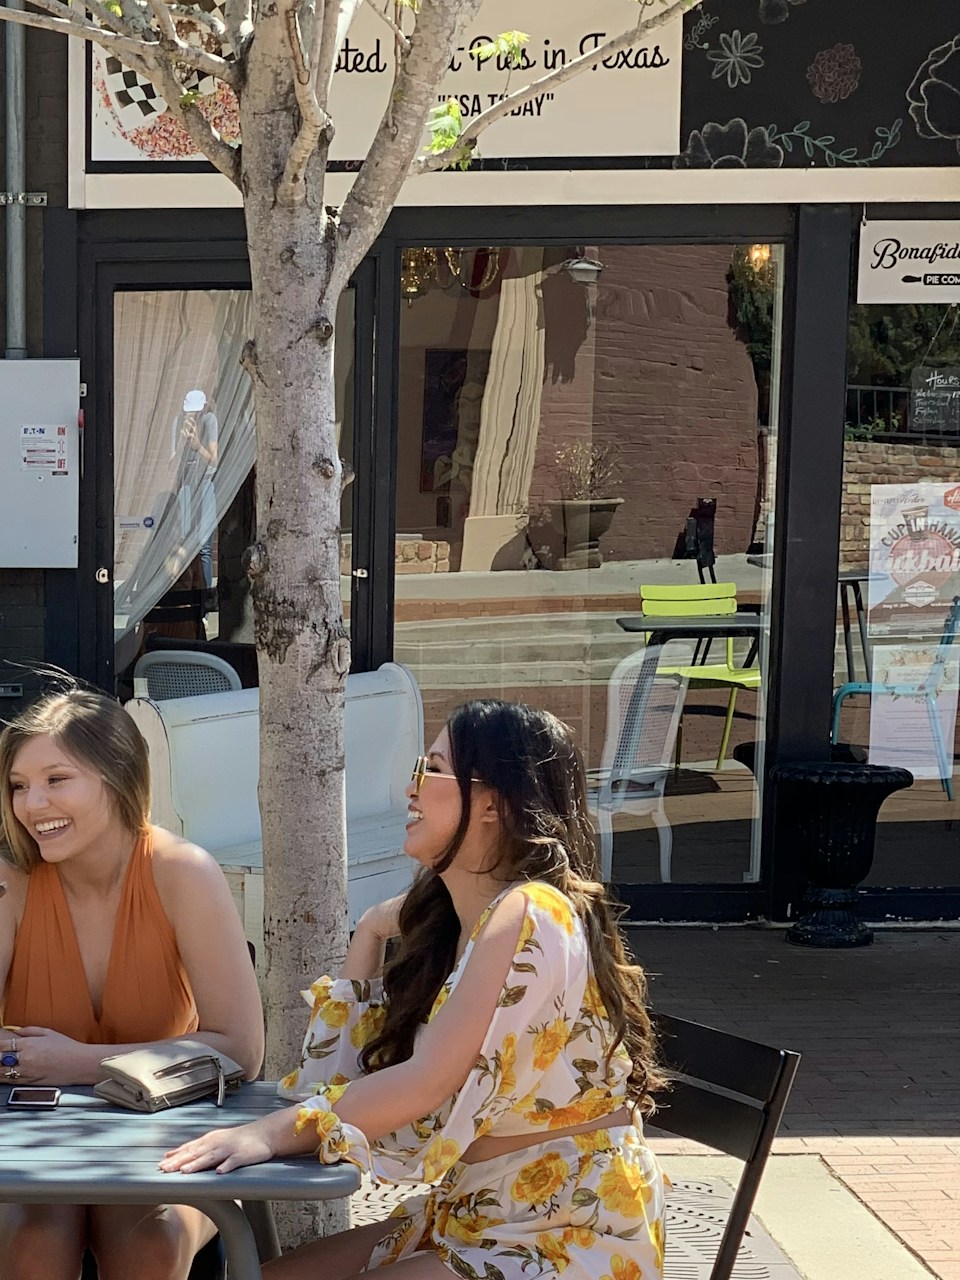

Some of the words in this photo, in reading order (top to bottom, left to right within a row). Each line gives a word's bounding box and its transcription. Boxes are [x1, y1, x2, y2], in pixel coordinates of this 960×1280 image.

[544, 39, 566, 70] in
[438, 94, 481, 117] "SA
[487, 93, 554, 117] TAY"
[870, 238, 960, 269] Bonafid
[926, 275, 940, 285] PIE
[881, 523, 906, 547] CUP
[910, 517, 926, 533] IN
